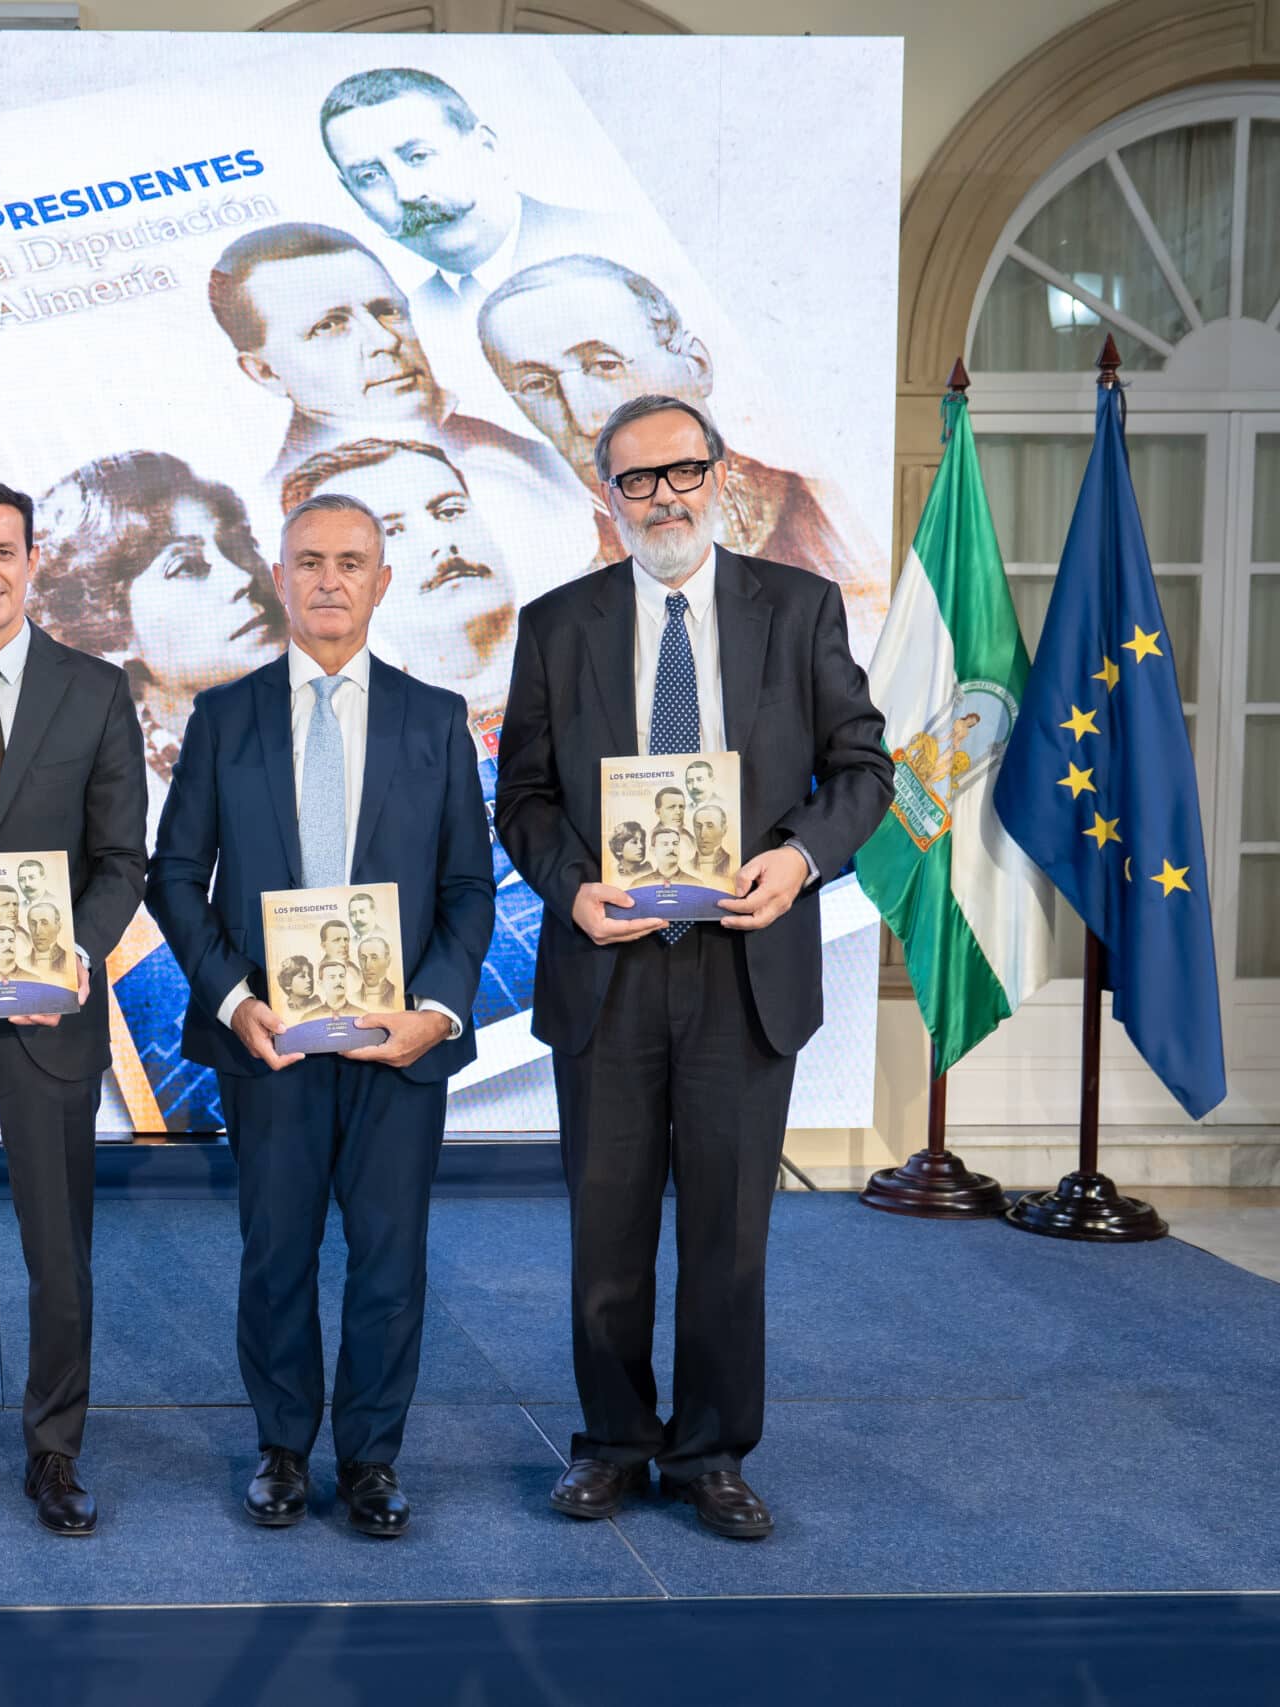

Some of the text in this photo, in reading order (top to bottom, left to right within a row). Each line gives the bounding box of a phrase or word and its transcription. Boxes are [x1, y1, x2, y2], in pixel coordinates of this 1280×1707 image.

[17, 194, 279, 272] Diputación
[625, 771, 675, 779] PRESIDENTES
[289, 904, 338, 913] PRESIDENTES
